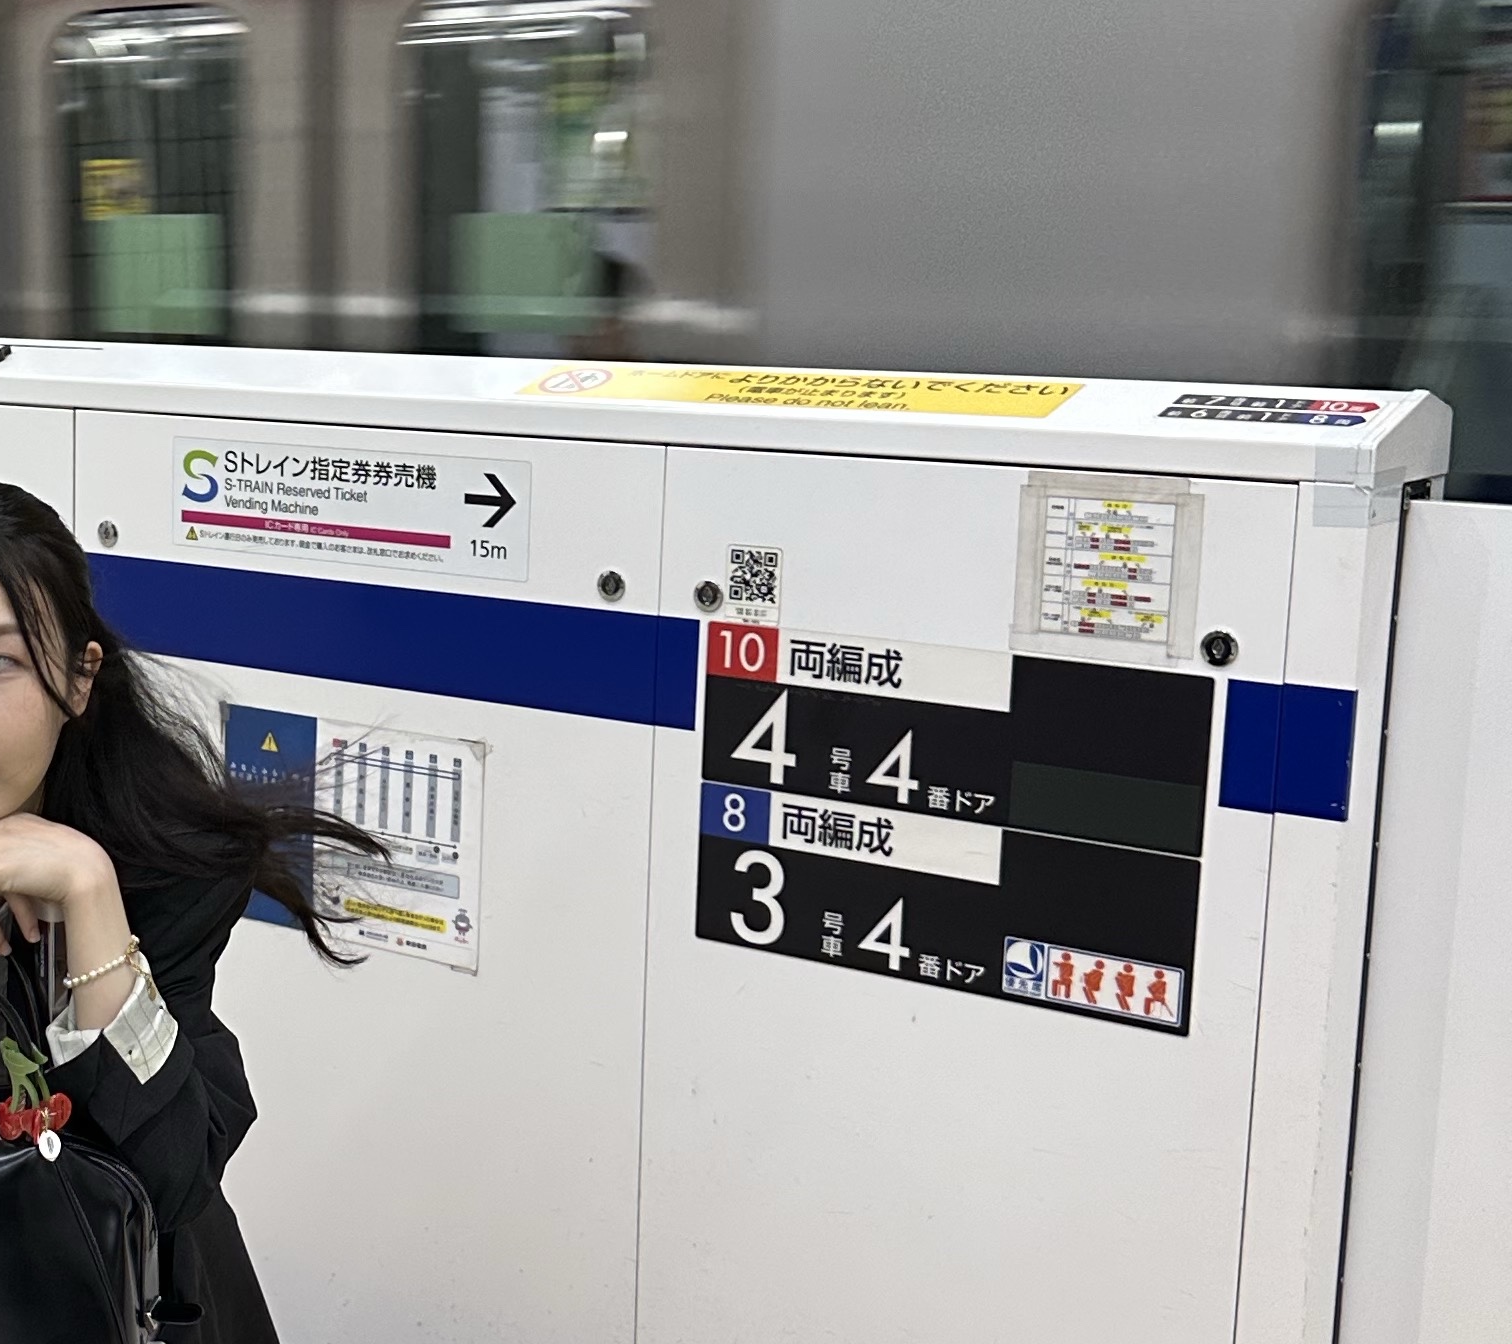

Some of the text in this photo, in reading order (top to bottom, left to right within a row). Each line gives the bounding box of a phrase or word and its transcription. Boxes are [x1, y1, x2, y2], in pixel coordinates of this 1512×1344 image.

[729, 373, 1069, 395] よりかからないでください
[704, 393, 910, 411] Please do not lean.
[1204, 396, 1226, 406] 7
[1190, 409, 1207, 418] 6
[1308, 415, 1329, 424] 8
[224, 451, 437, 491] Sトレイン指定券券売機
[224, 478, 368, 503] S-TRAIN Reserved Ticket
[224, 495, 319, 516] Vending Machine
[470, 539, 508, 561] 15m
[719, 630, 903, 689] 10 両編成
[730, 688, 796, 785] 4
[866, 730, 919, 804] 4
[927, 787, 995, 815] 番ドア
[721, 793, 894, 857] 8 両編成
[730, 850, 785, 945] 3
[857, 897, 910, 971] 4
[918, 954, 985, 985] 番ドア
